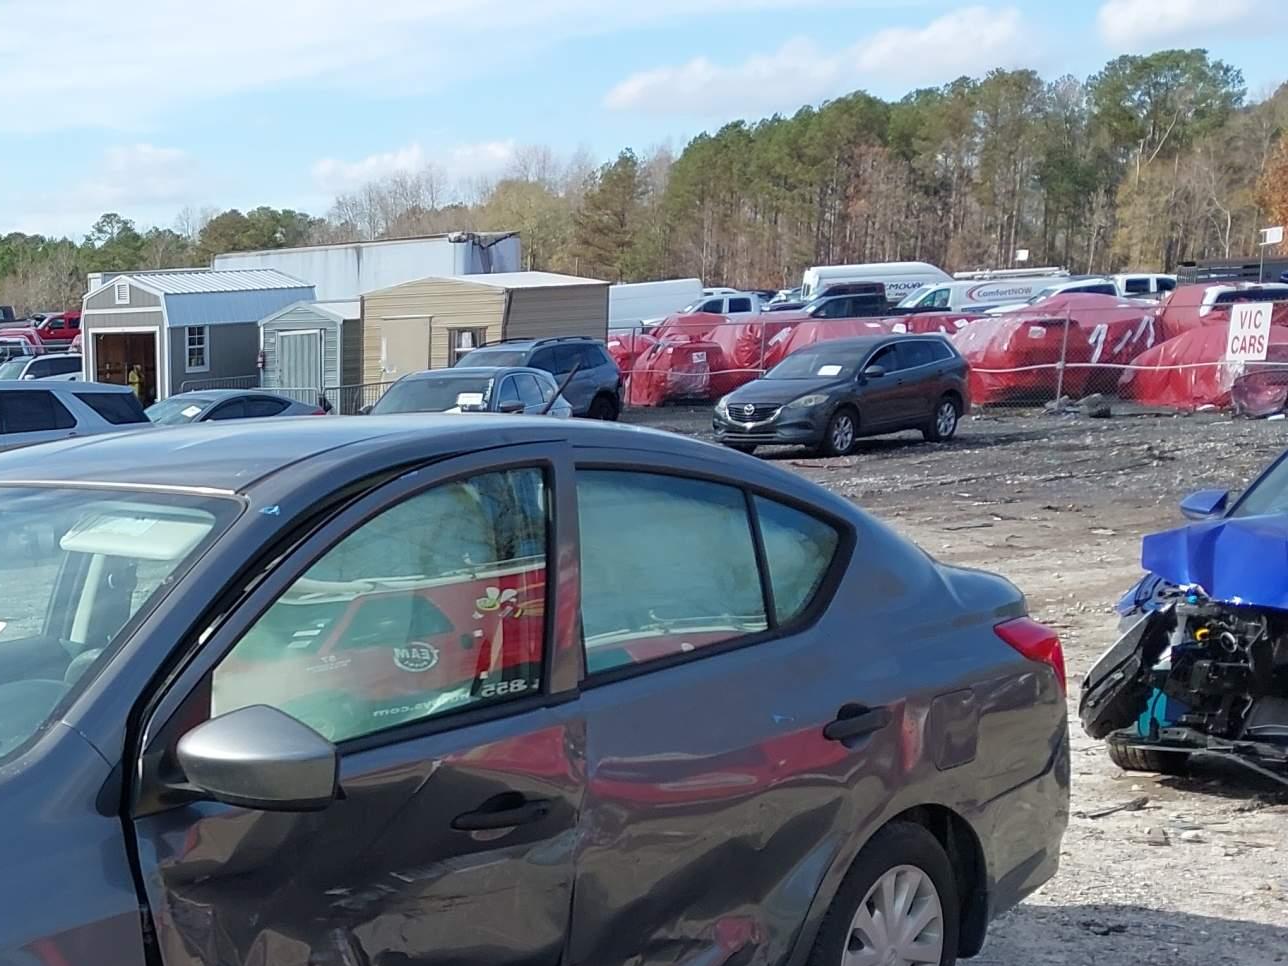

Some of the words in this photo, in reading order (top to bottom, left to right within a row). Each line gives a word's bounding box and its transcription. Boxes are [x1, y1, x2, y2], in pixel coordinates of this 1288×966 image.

[977, 287, 1032, 297] ComfortNOW
[1240, 310, 1263, 329] VIC
[1230, 335, 1265, 354] CARS
